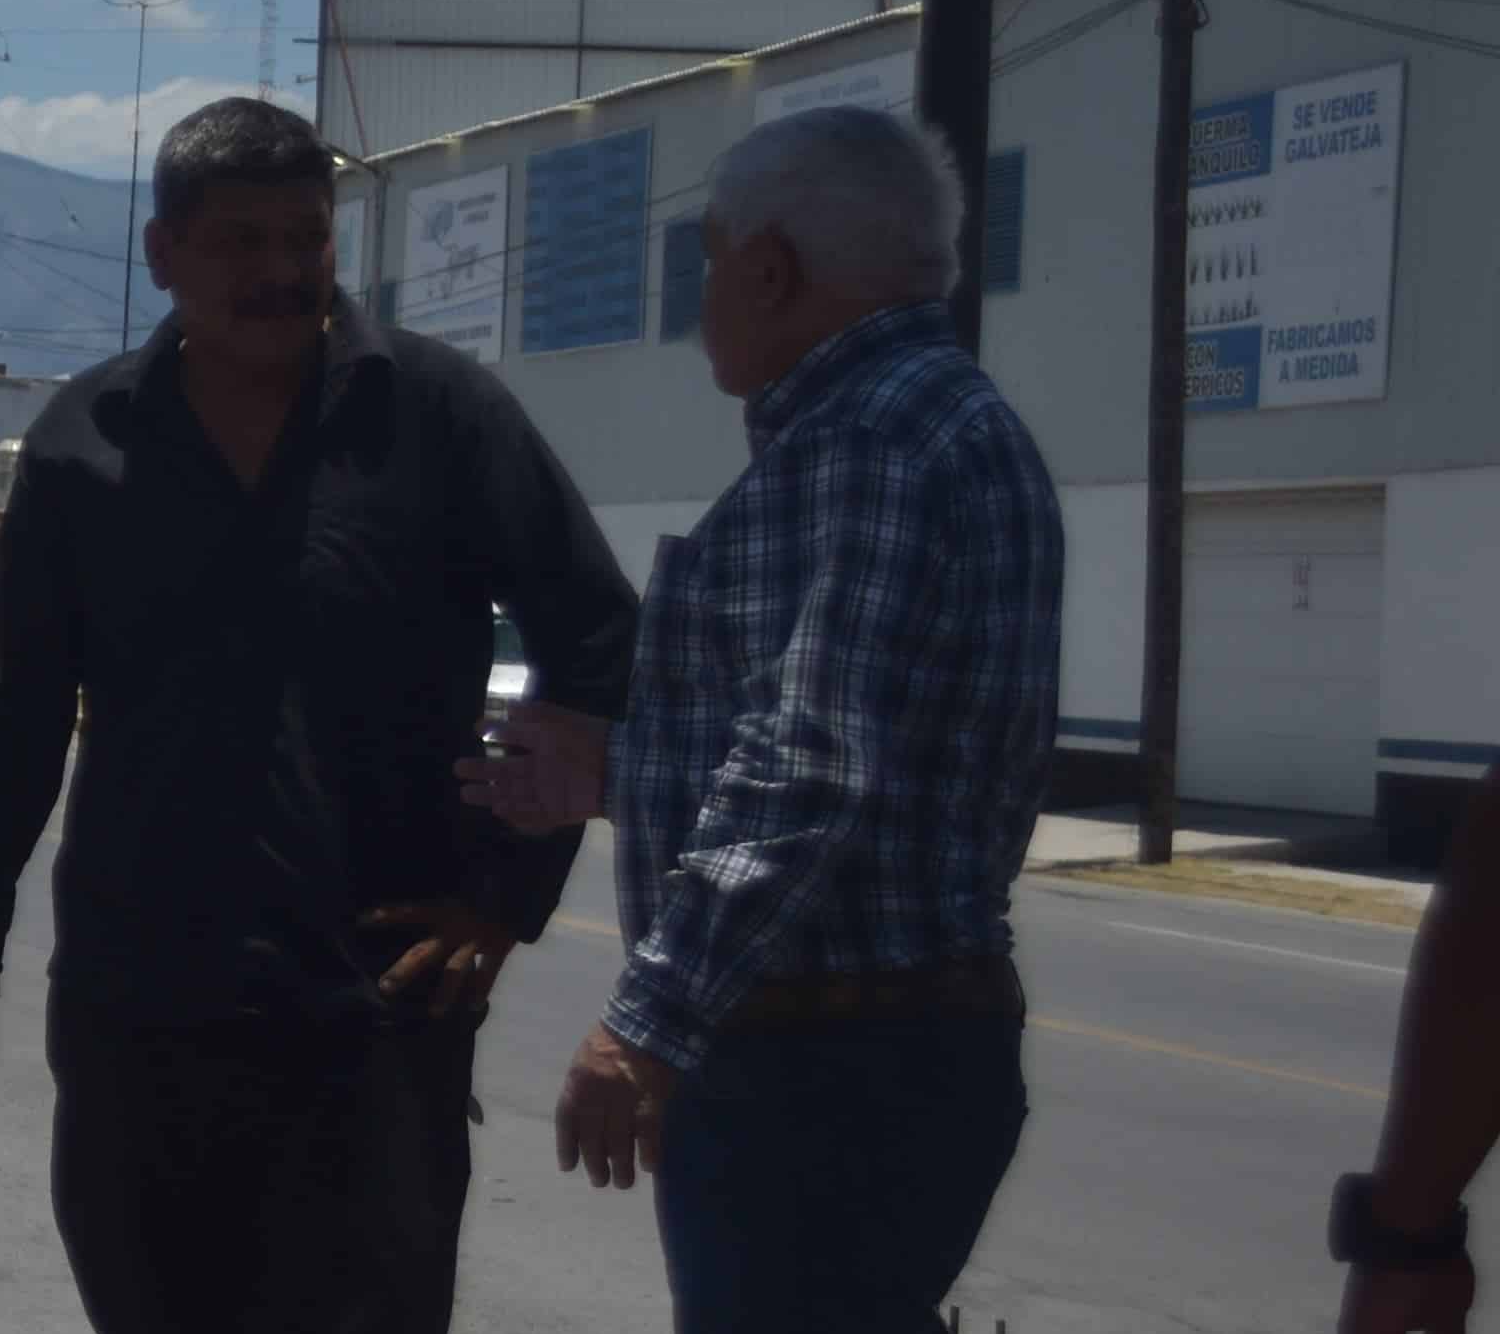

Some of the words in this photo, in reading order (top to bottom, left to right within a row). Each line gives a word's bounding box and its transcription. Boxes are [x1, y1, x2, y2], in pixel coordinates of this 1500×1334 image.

[1291, 101, 1315, 131] SE
[1319, 90, 1378, 125] VENDE
[1187, 141, 1260, 177] ANQUILO
[1284, 123, 1384, 164] GALVATEJA
[1266, 316, 1377, 354] FABRICAMOS
[1279, 361, 1290, 383] A
[1293, 351, 1360, 382] MEDIDA
